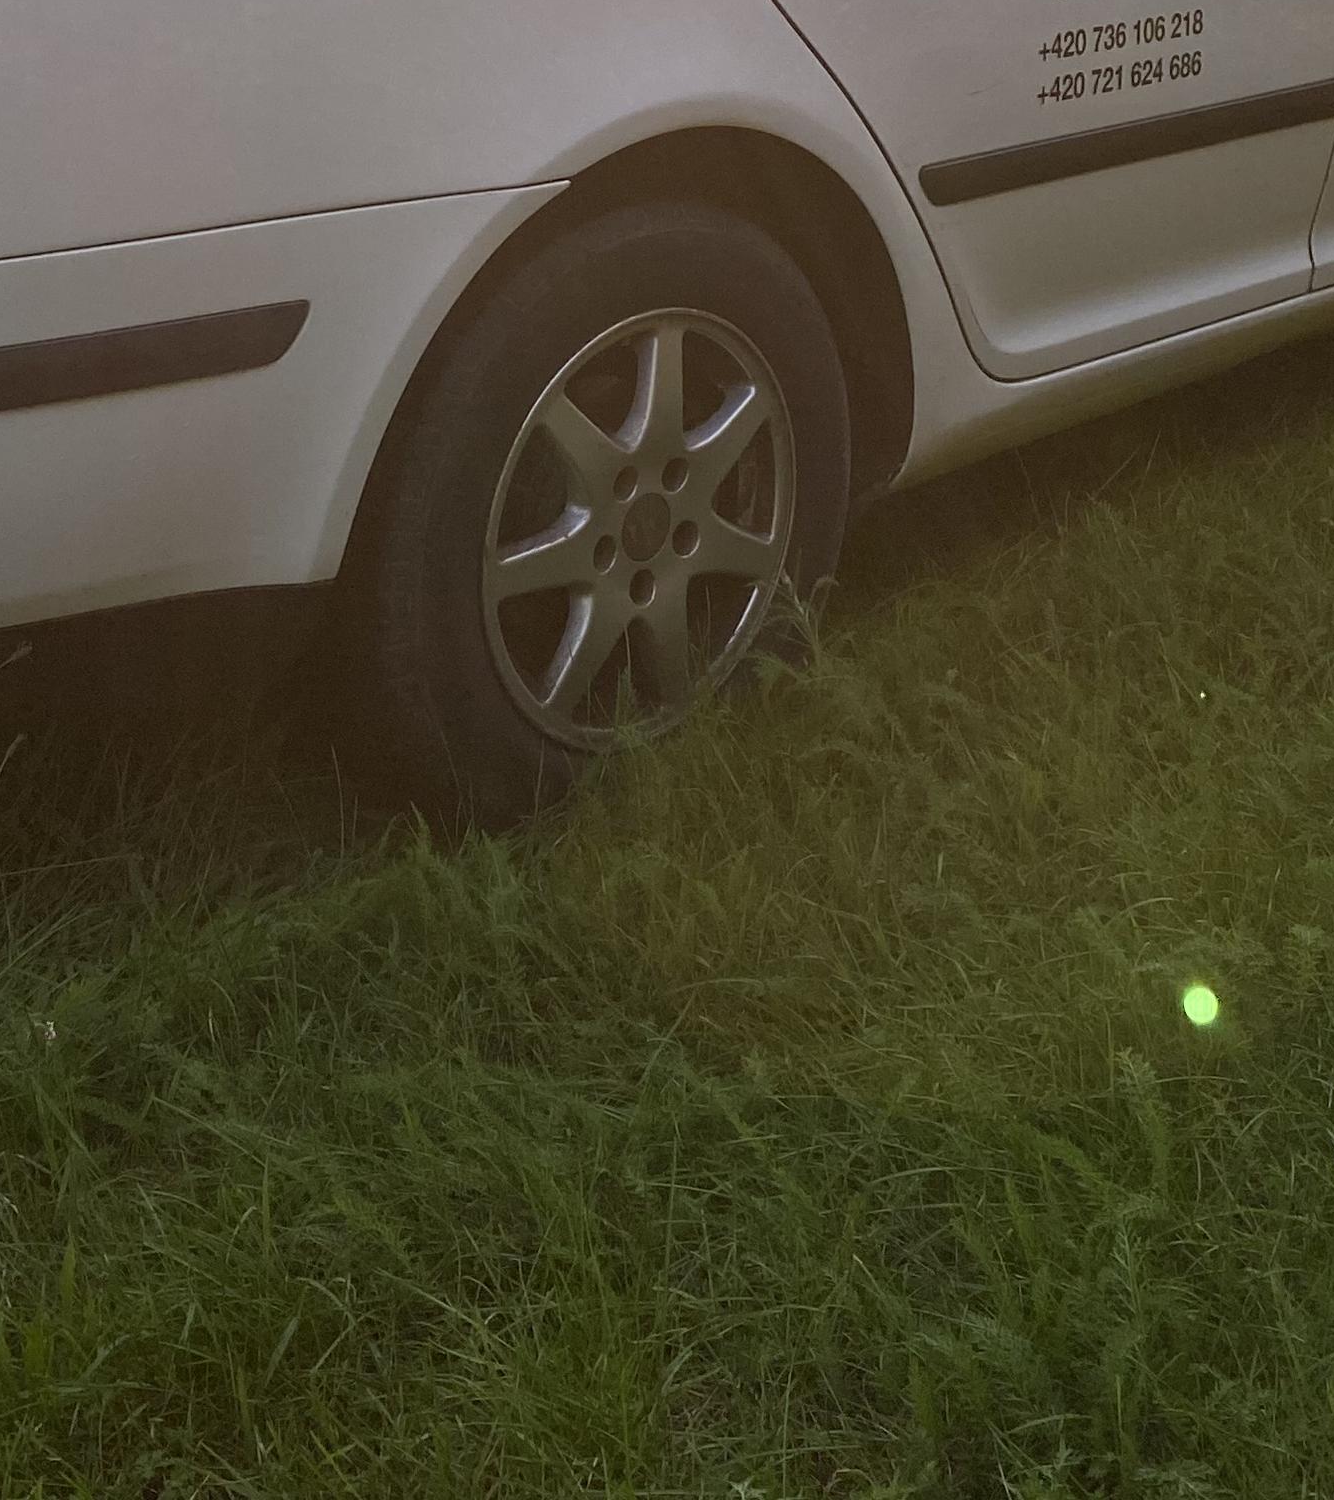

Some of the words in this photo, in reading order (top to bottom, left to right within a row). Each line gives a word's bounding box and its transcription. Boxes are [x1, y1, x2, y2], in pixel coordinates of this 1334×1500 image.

[1038, 28, 1087, 62] +420
[1093, 22, 1127, 51] 736
[1133, 16, 1165, 46] 106
[1170, 9, 1204, 38] 218
[1037, 73, 1085, 105] +420
[1091, 65, 1124, 95] 721
[1130, 58, 1164, 88] 624
[1169, 50, 1203, 80] 686
